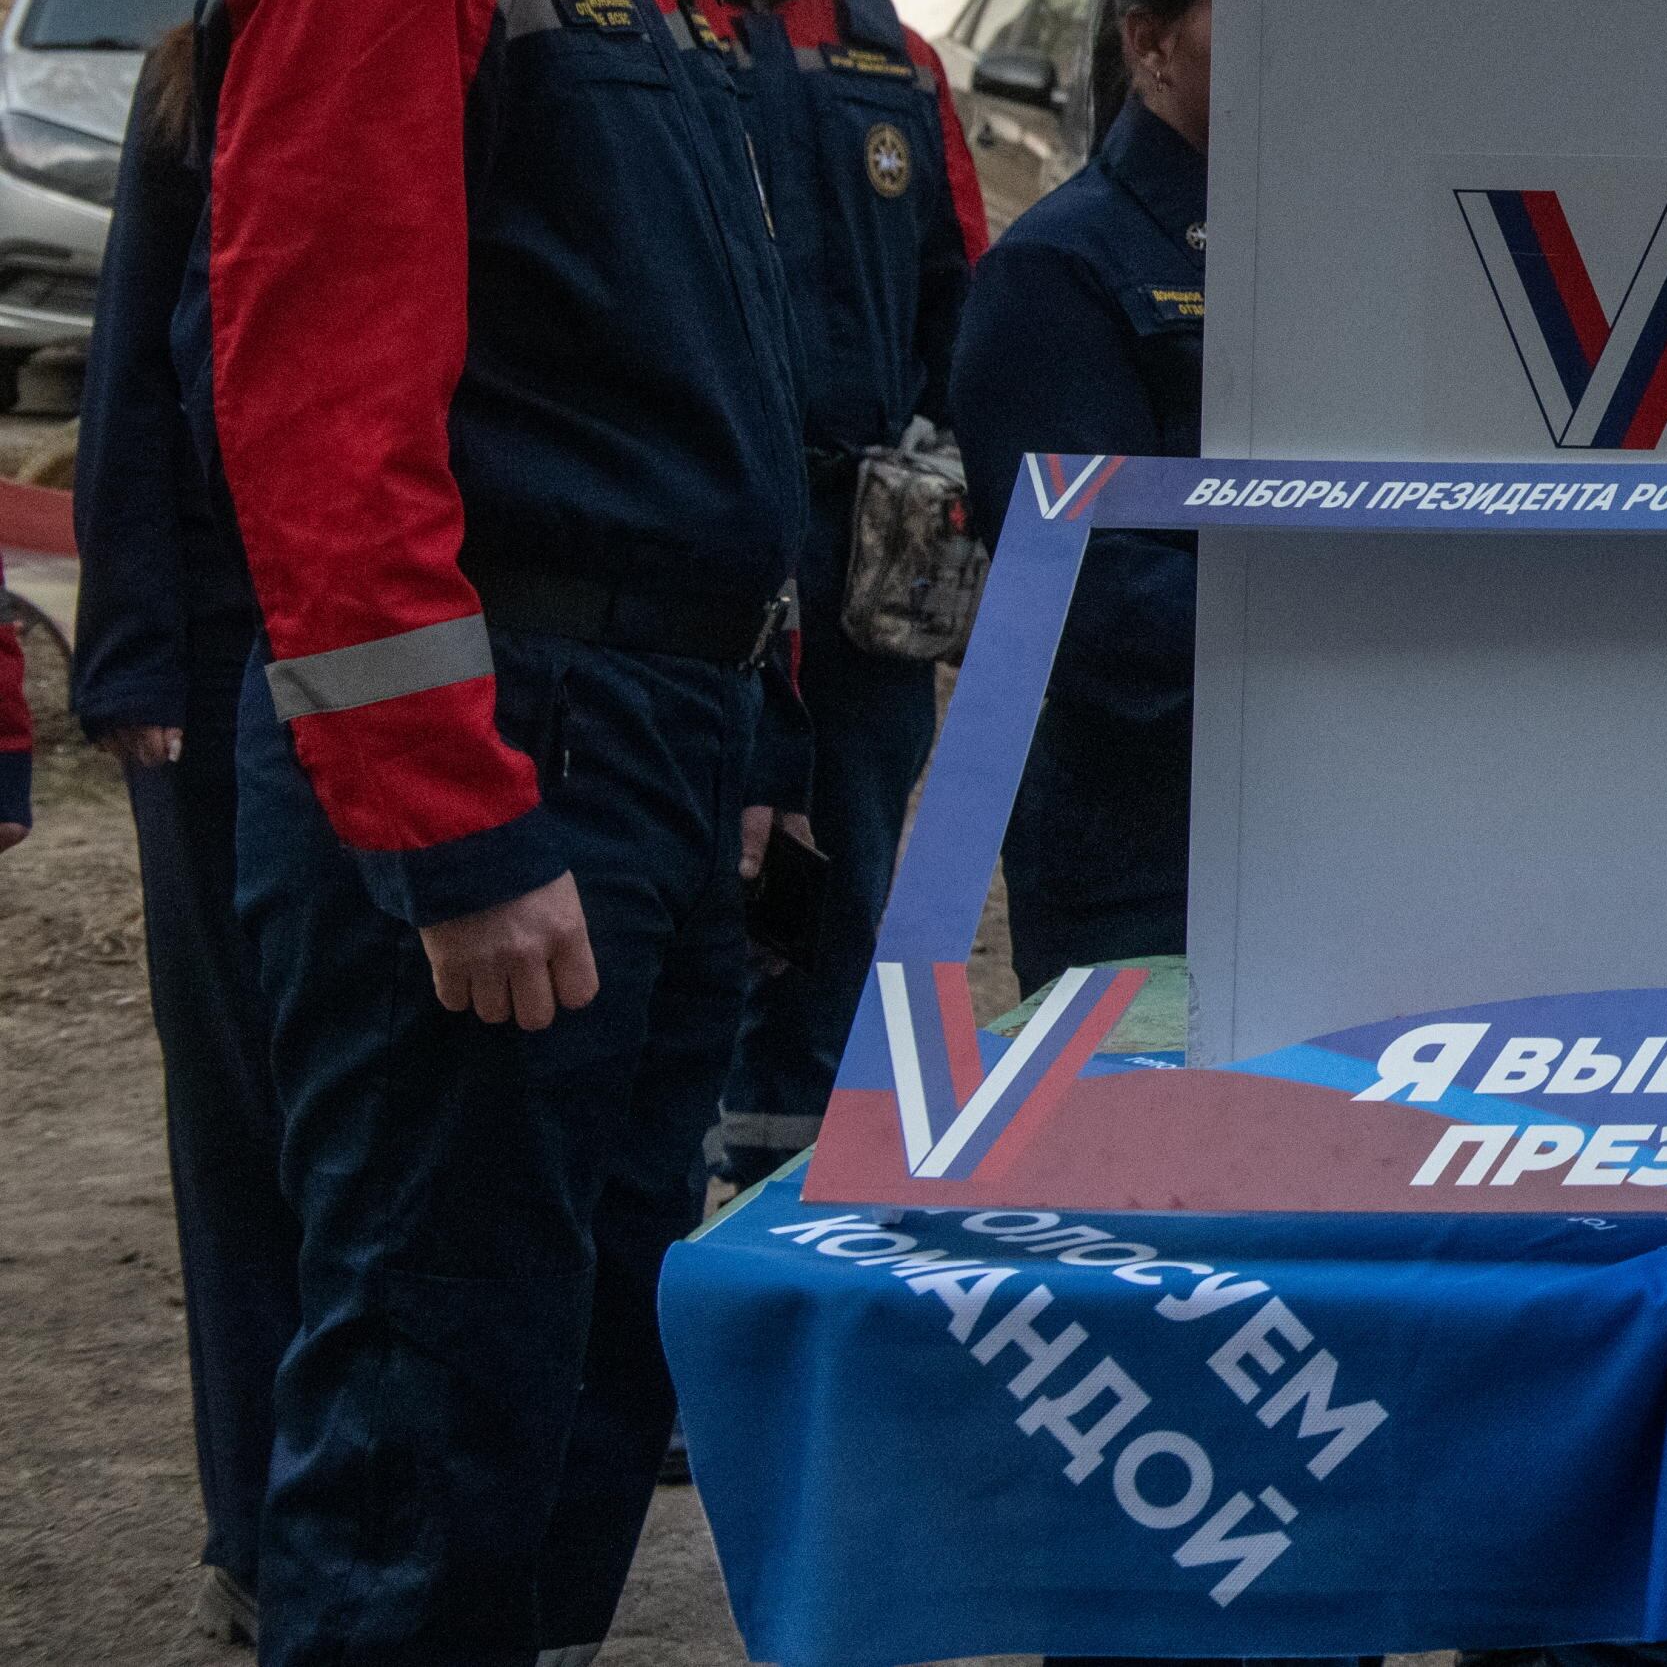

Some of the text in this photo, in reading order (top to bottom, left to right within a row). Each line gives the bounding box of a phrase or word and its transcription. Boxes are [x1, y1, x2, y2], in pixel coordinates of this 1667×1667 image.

[1184, 476, 1363, 510] ВЫБОРЫ
[1366, 478, 1619, 516] ПРЕЗИДЕНТА
[1351, 1021, 1492, 1103] Я
[769, 1213, 1299, 1609] КОМАНДОЙ
[925, 1209, 1390, 1482] ОЛОСУЕМ
